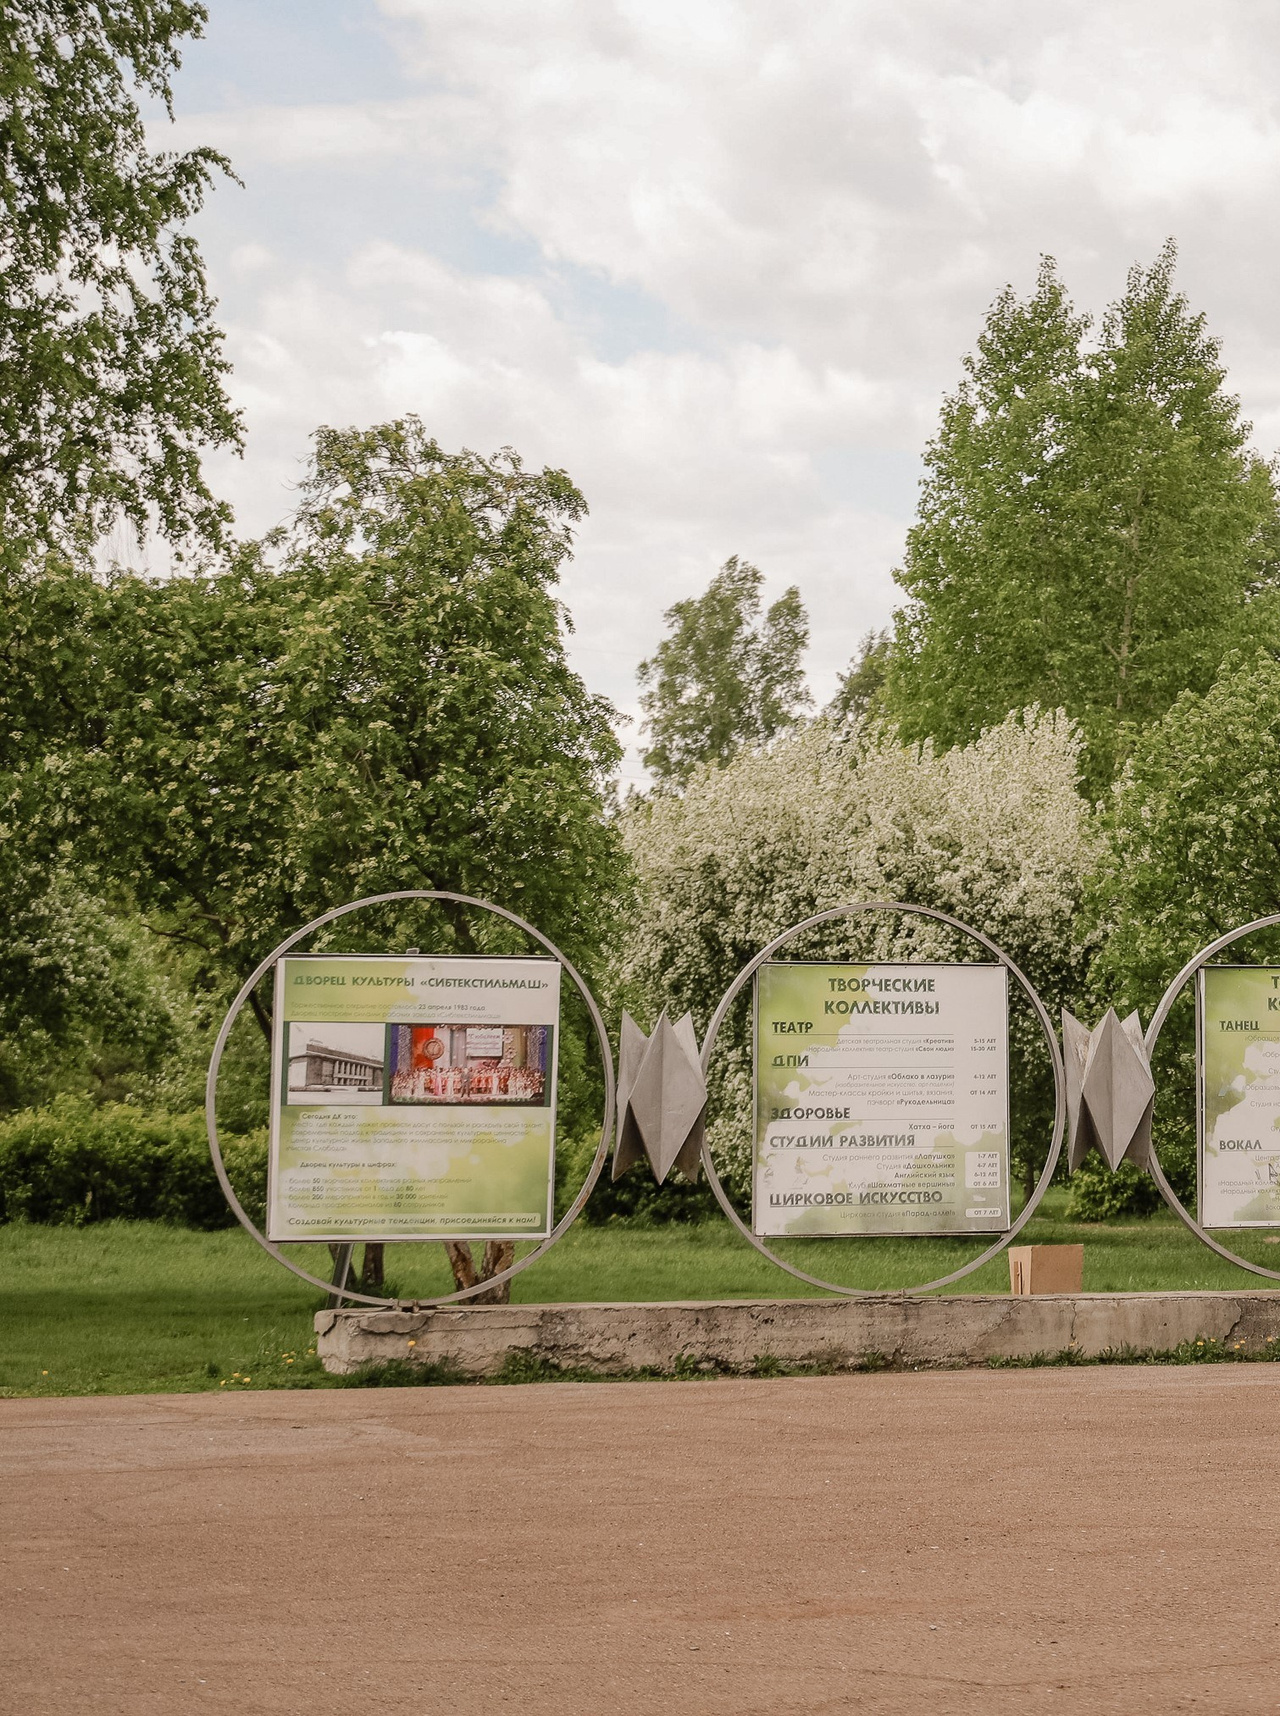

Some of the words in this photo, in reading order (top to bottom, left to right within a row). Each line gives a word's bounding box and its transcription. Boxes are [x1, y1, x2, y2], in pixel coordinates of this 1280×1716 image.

[293, 976, 347, 986] ДВОРЕЦ
[352, 976, 415, 987] КУЛЬТУРЫ
[420, 978, 548, 989] «СИБТЕКСТИЛЬМАШ»
[828, 977, 936, 993] ТВОРЧЕСКИЕ
[824, 1000, 940, 1016] КОЛЛЕКТИВЫ
[772, 1021, 814, 1034] ТЕАТР
[1219, 1021, 1260, 1031] ТАНЕЦ
[922, 1038, 955, 1046] «Креатив»
[771, 1055, 809, 1067] ДПИ
[771, 1108, 850, 1119] ЗДОРОВЬЕ
[938, 1122, 955, 1130] йога
[769, 1136, 833, 1147] СТУДИИ
[840, 1135, 915, 1147] РАЗВИТИЯ
[1219, 1140, 1262, 1150] ВОКАЛ
[914, 1153, 955, 1161] «Лапушка»
[300, 1161, 327, 1169] Дворец
[769, 1193, 853, 1206] ЦИРКОВОЕ
[860, 1191, 943, 1204] ИСКУССТВО
[439, 1217, 506, 1225] присоединяйся
[515, 1216, 537, 1224] нам!
